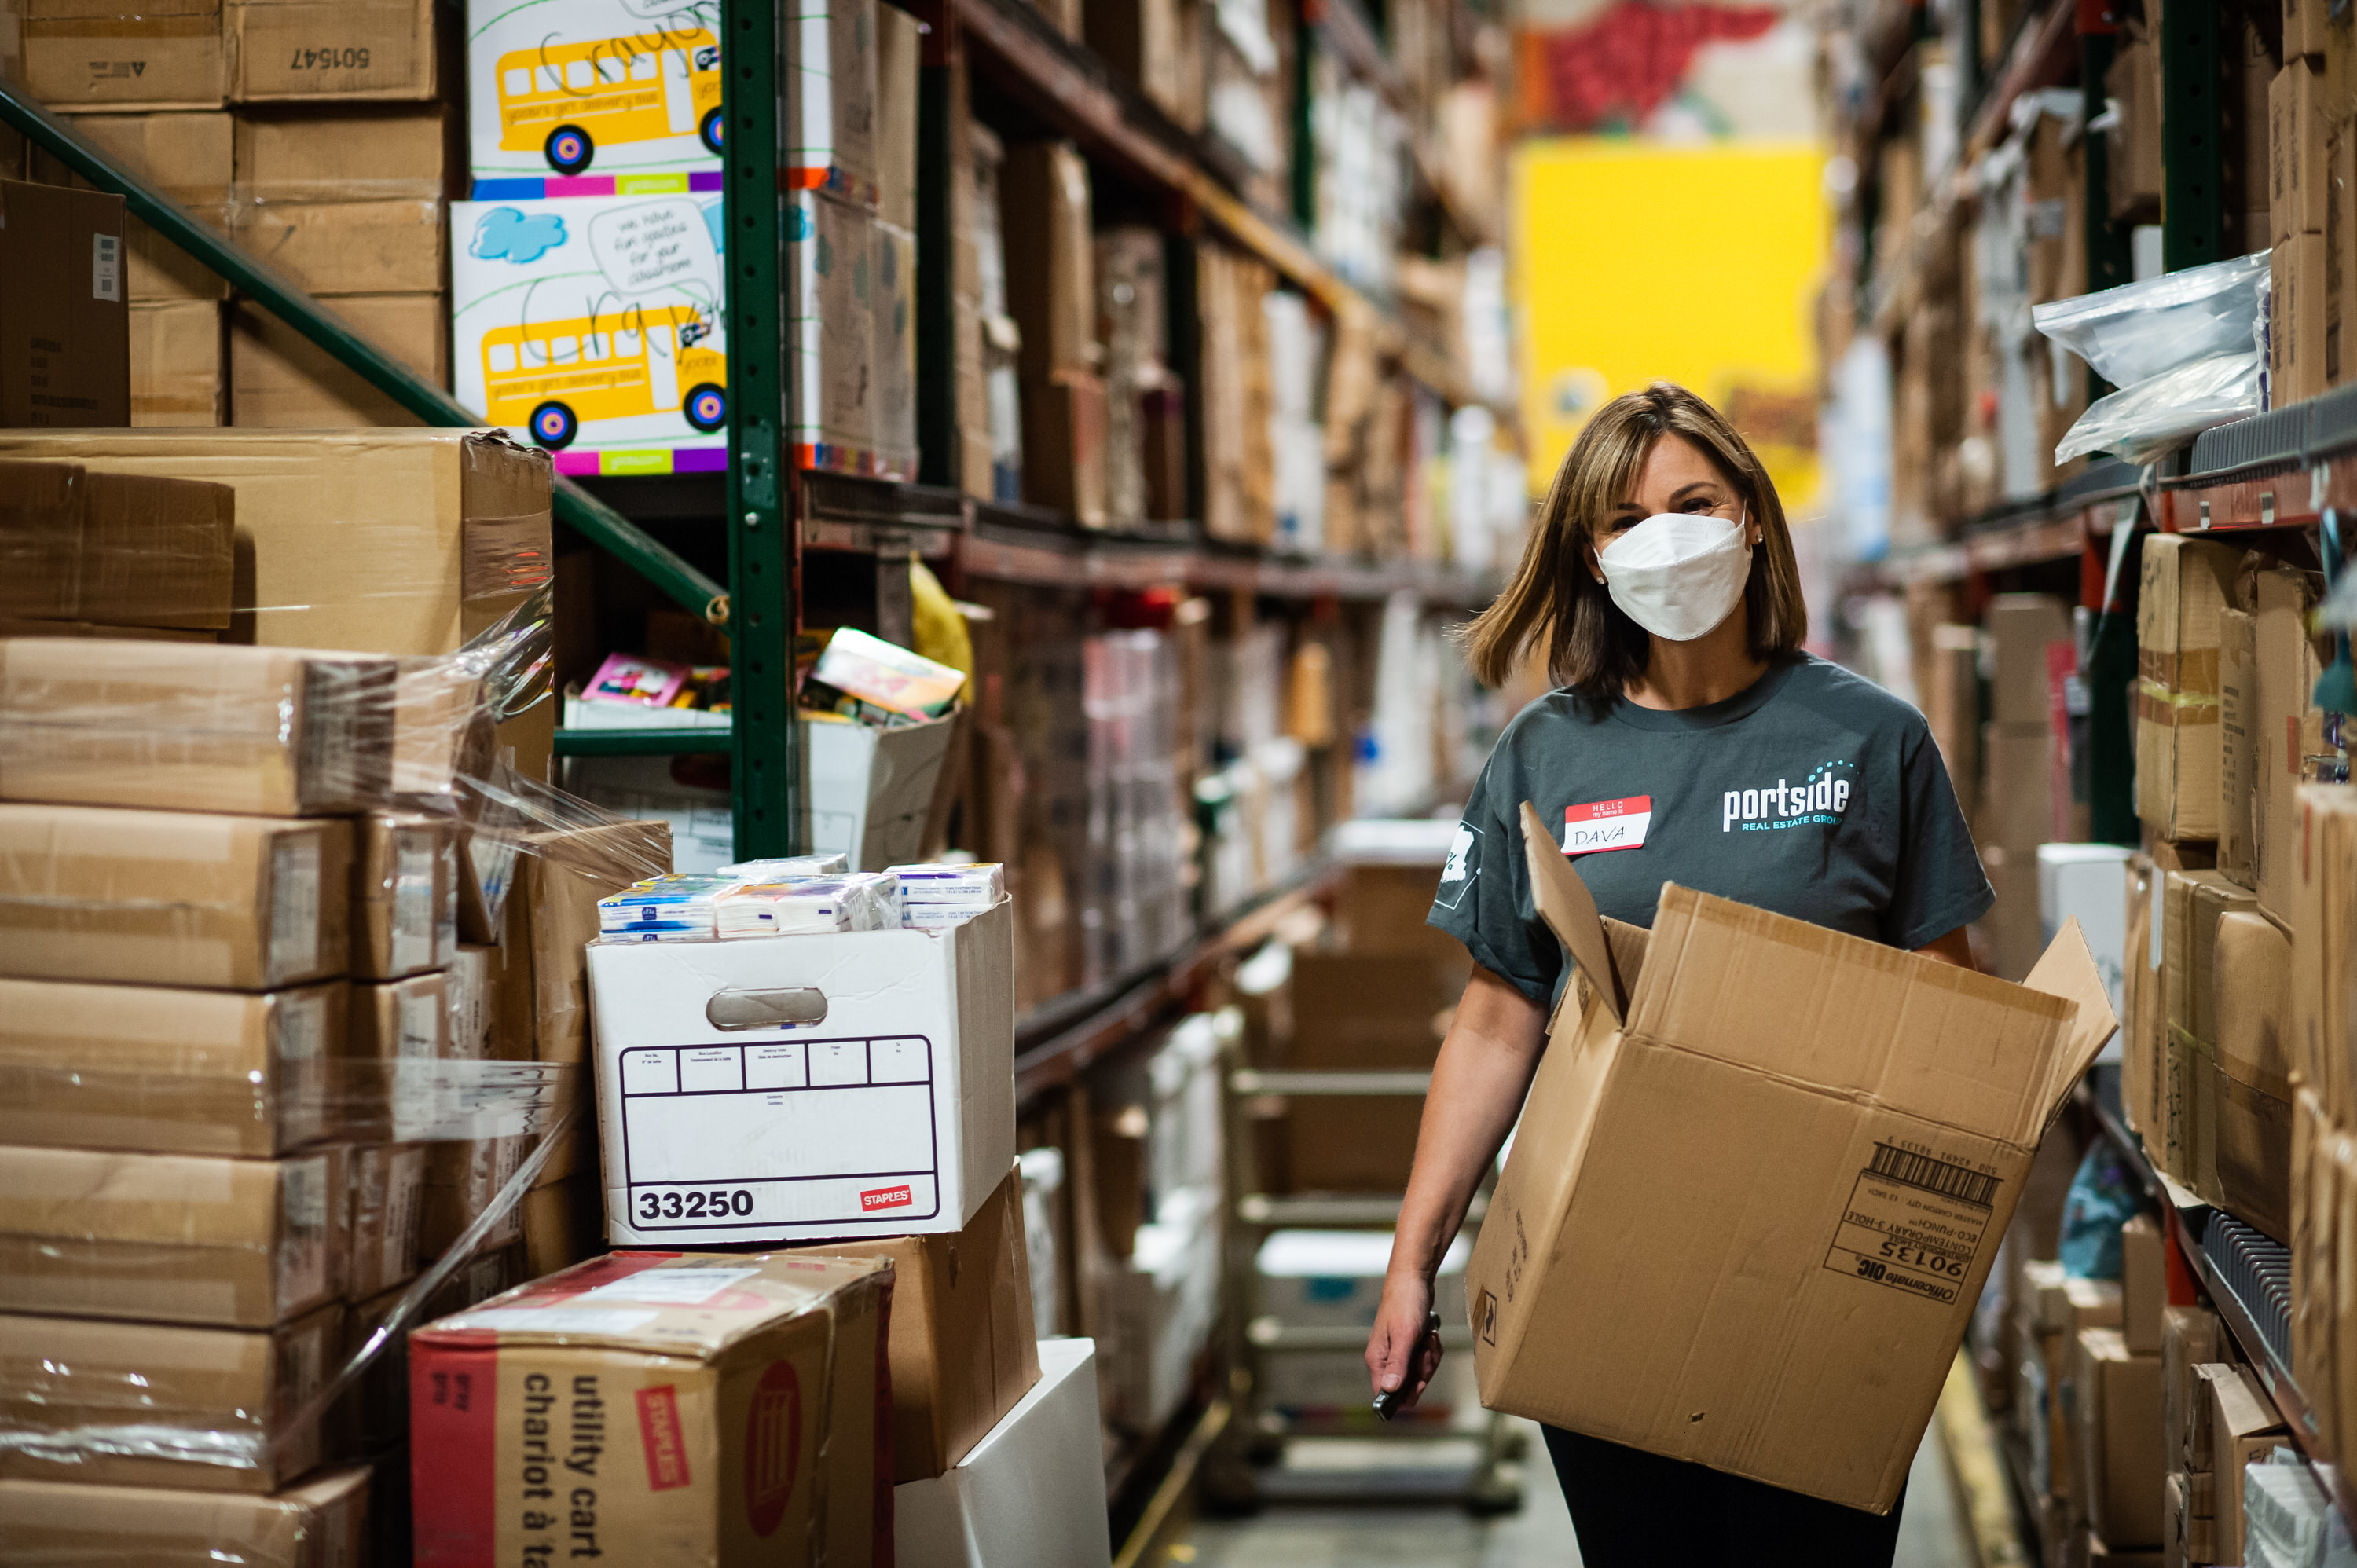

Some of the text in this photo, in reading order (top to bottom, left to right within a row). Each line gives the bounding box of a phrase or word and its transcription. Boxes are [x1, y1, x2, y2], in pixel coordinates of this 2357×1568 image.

[291, 48, 369, 69] 501547
[1593, 801, 1623, 811] HELLO
[1723, 772, 1849, 832] portside
[1742, 814, 1842, 831] REAL ESTATE GROUP
[1574, 826, 1624, 845] DAVA
[1901, 1140, 1932, 1155] 90135
[1941, 1152, 1970, 1167] 42491
[1978, 1163, 1997, 1174] 500
[639, 1190, 753, 1219] 33250
[864, 1190, 909, 1207] STAPLES
[1923, 1204, 1953, 1218] CARTON
[1954, 1213, 1982, 1226] MASTER
[1846, 1211, 1971, 1253] CONTEMPORARY 3-HOLE
[1879, 1241, 1962, 1277] 90135
[1857, 1258, 1954, 1300] Officemate OIC
[522, 1373, 555, 1499] chariot
[564, 1376, 604, 1558] utility cart
[522, 1511, 555, 1530] à
